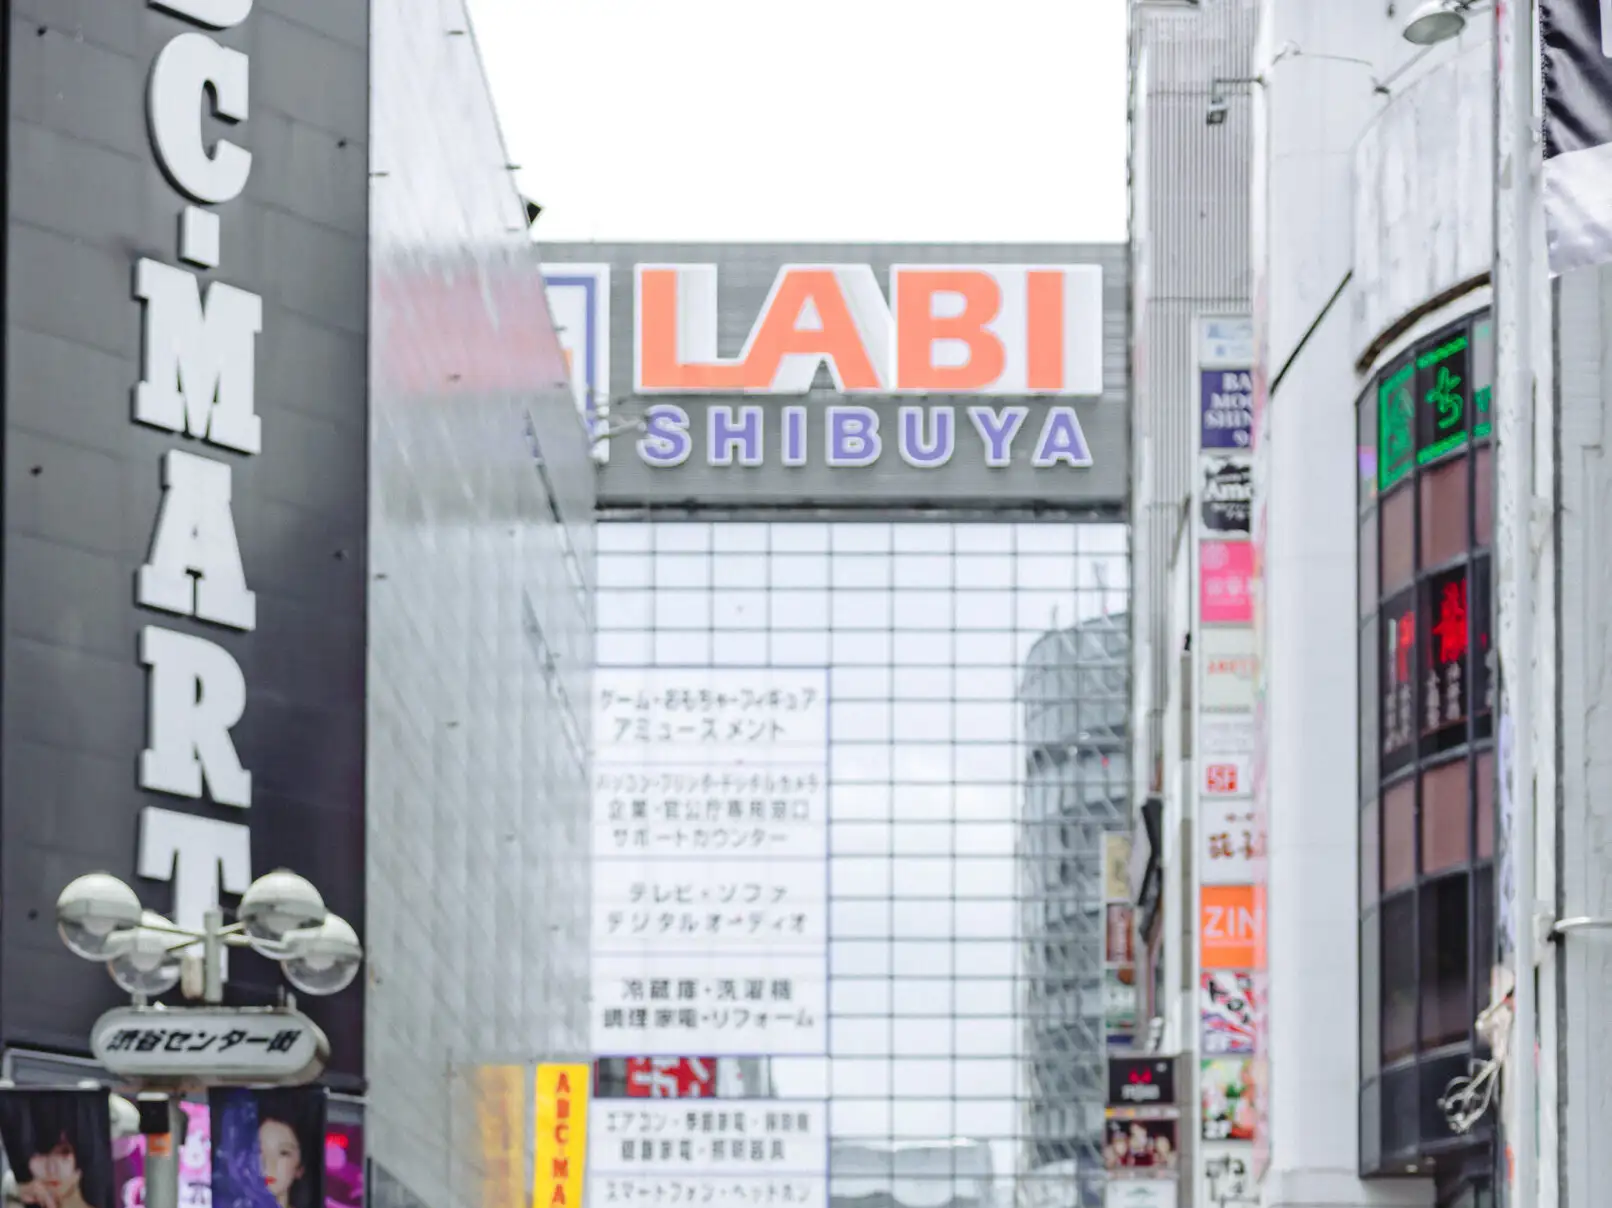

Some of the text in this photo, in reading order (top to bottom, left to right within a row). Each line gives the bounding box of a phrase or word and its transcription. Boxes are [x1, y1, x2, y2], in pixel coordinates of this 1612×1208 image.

[634, 263, 1102, 394] LABI
[637, 404, 1093, 468] SHIBUYA
[133, 0, 262, 976] C-MART
[621, 977, 794, 1001] 冷蔵庫・洗濯機
[106, 1029, 302, 1053] 渋谷センター街
